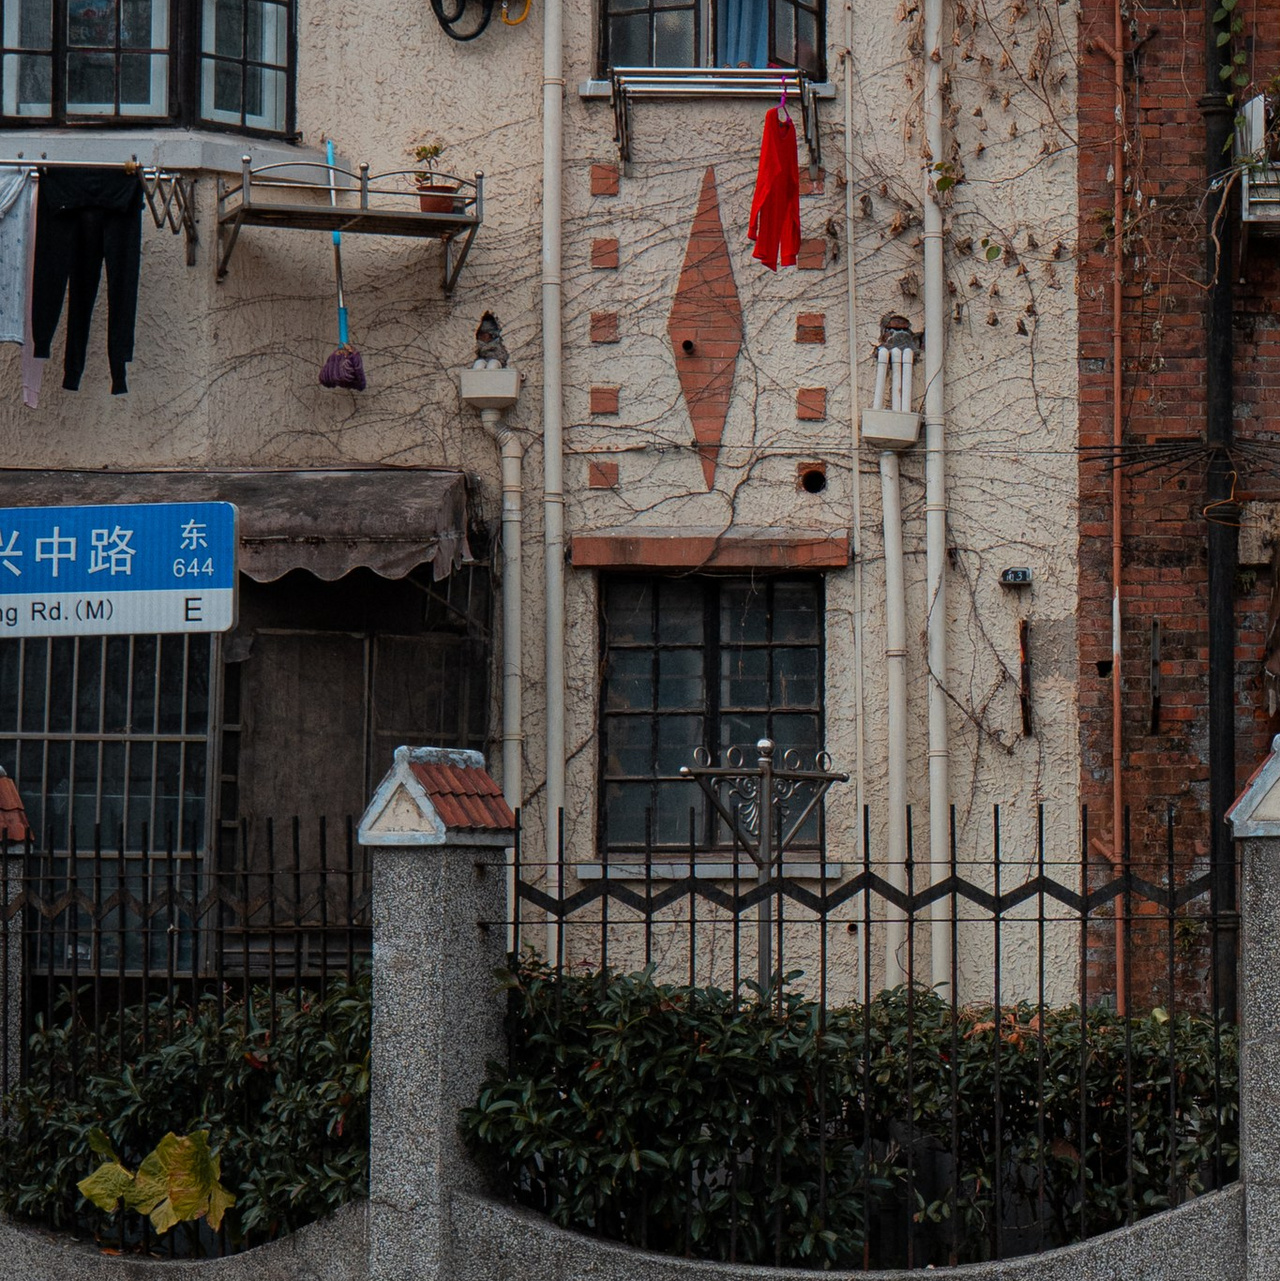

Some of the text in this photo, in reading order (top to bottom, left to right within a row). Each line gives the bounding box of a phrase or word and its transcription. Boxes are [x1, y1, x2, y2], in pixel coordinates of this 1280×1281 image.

[180, 518, 209, 551] 东
[173, 557, 215, 578] 644
[184, 597, 203, 622] E
